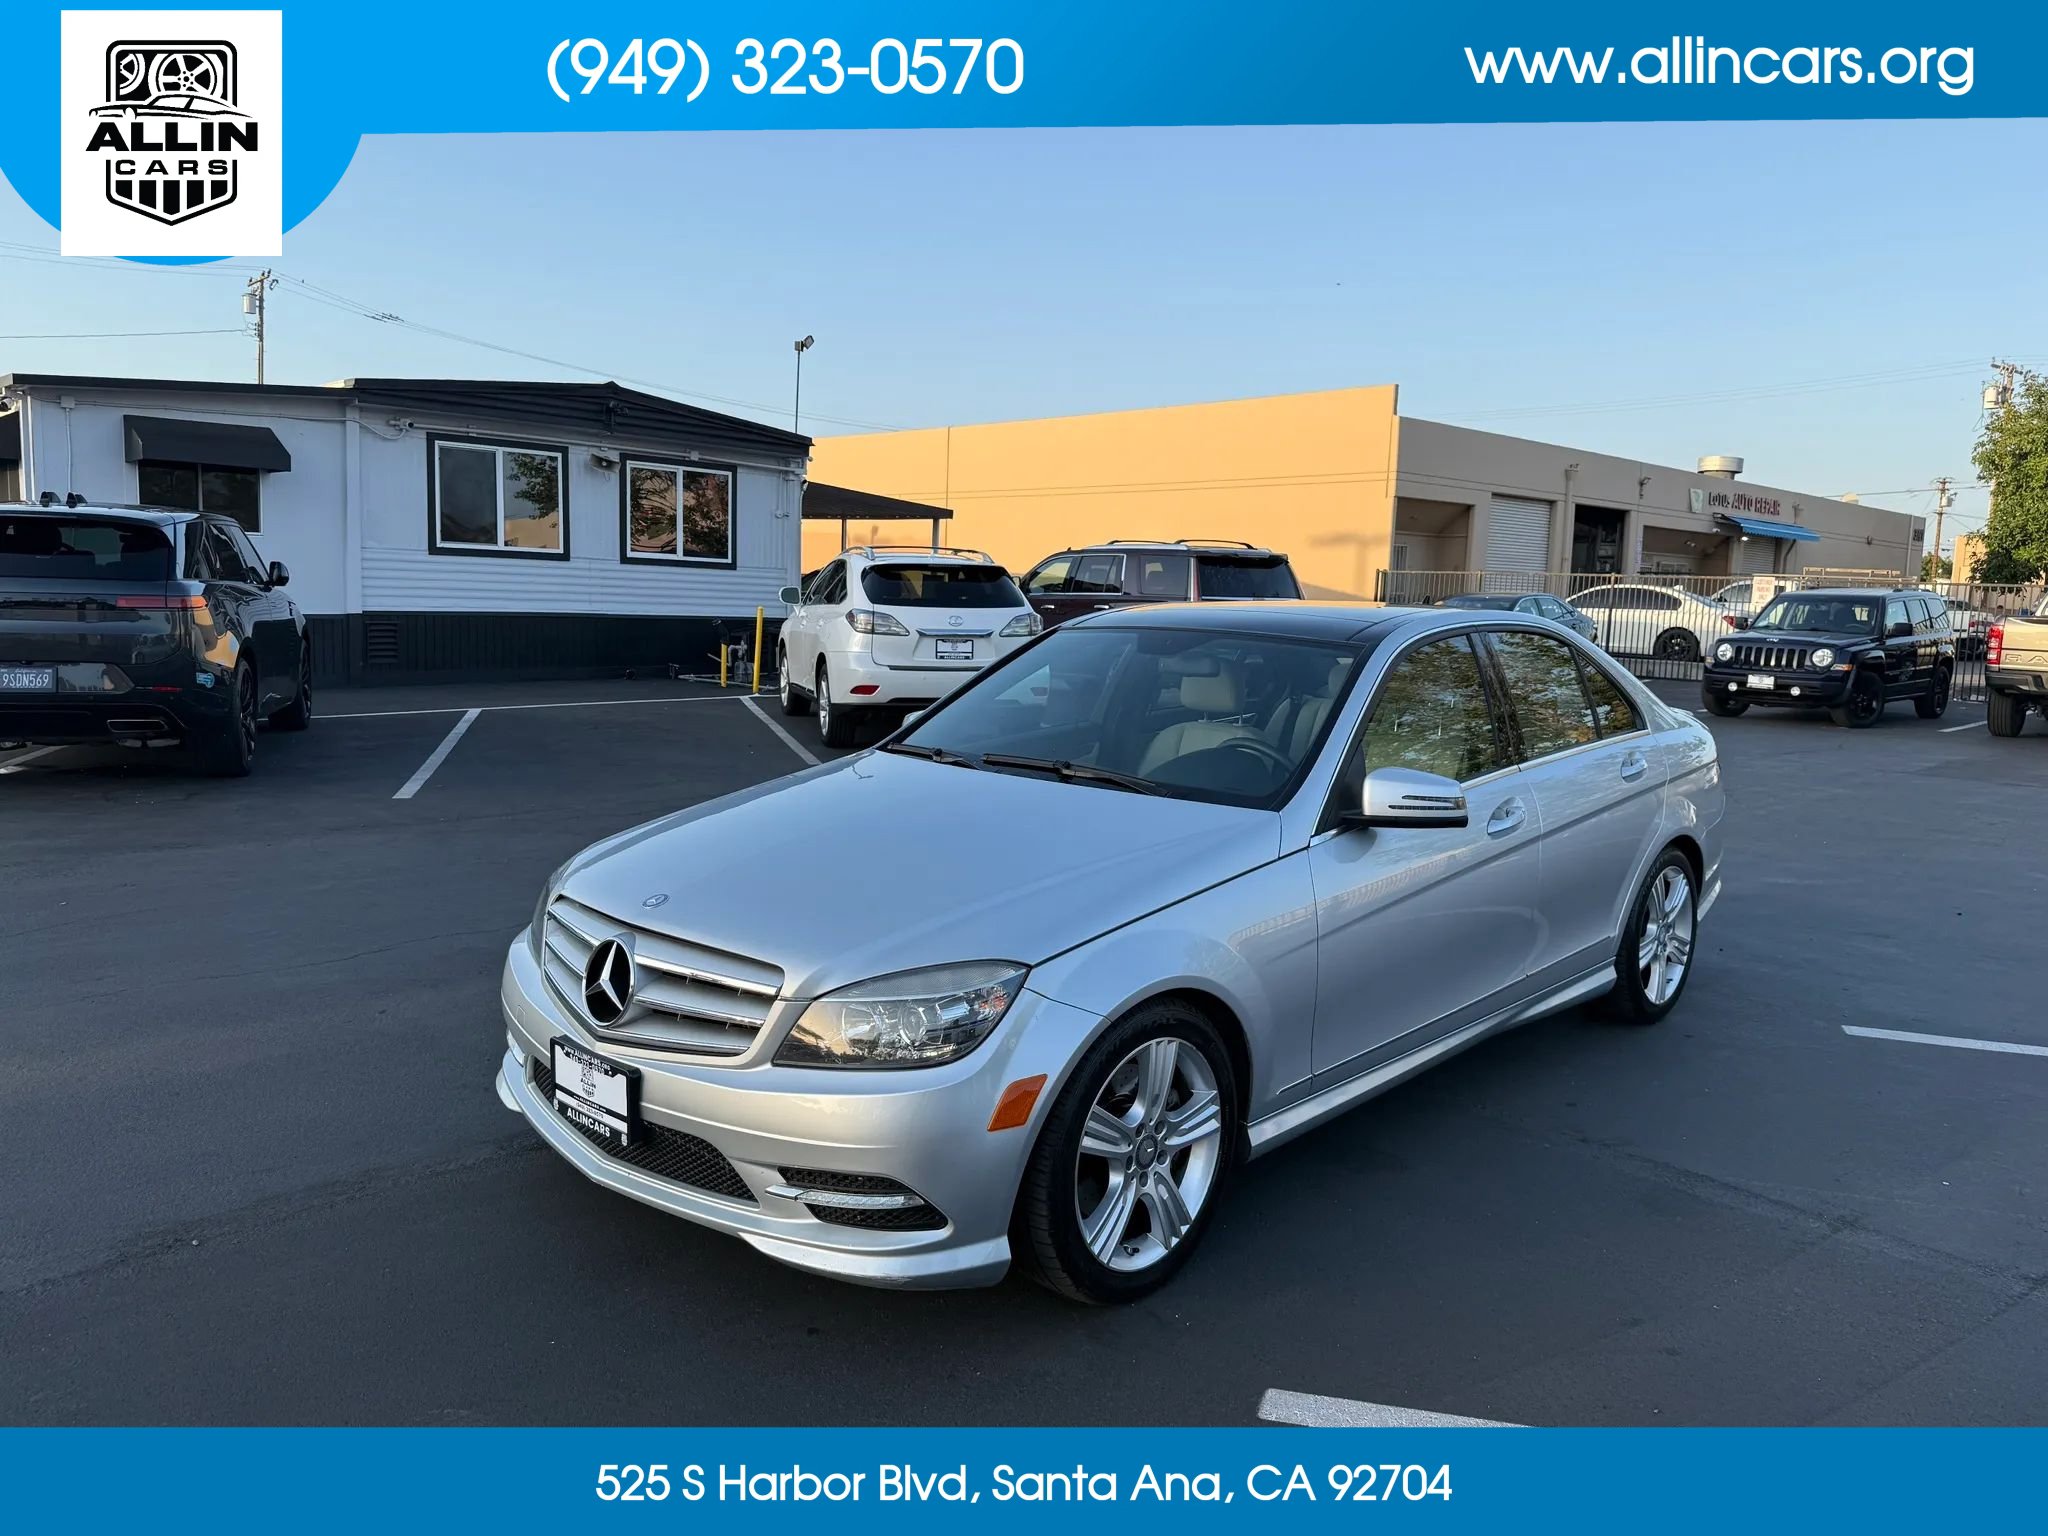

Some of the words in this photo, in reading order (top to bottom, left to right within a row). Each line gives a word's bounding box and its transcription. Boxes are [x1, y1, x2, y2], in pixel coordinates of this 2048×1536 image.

[1731, 493, 1753, 512] AUTO
[1755, 497, 1780, 516] REPAIR
[2, 673, 49, 687] 9SDN569
[566, 1107, 611, 1138] ALLINCARS
